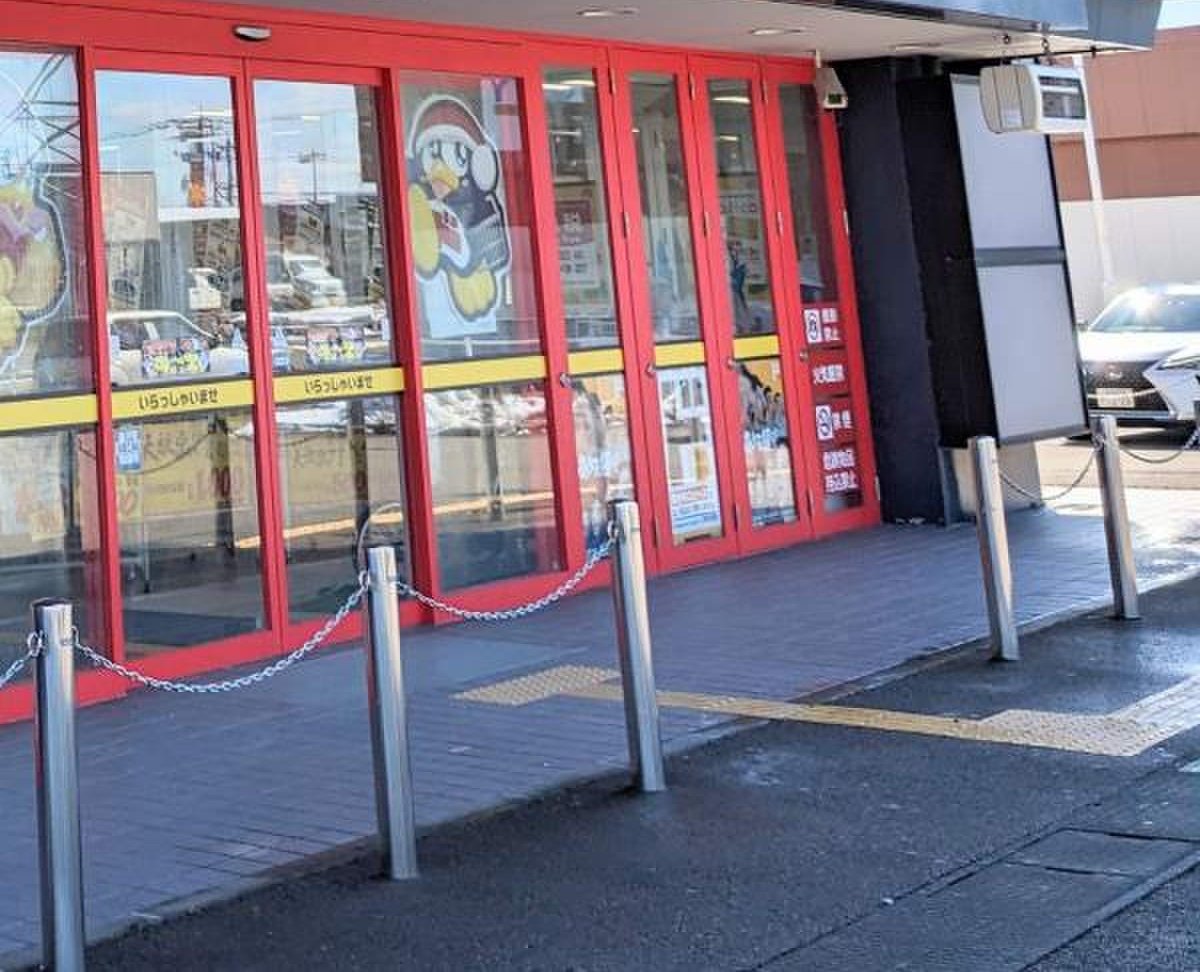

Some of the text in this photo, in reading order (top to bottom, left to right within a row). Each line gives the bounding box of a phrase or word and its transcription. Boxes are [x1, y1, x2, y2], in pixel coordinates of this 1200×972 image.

[304, 375, 373, 394] いらっしゃいませ
[138, 387, 218, 410] いらっしゃいませ
